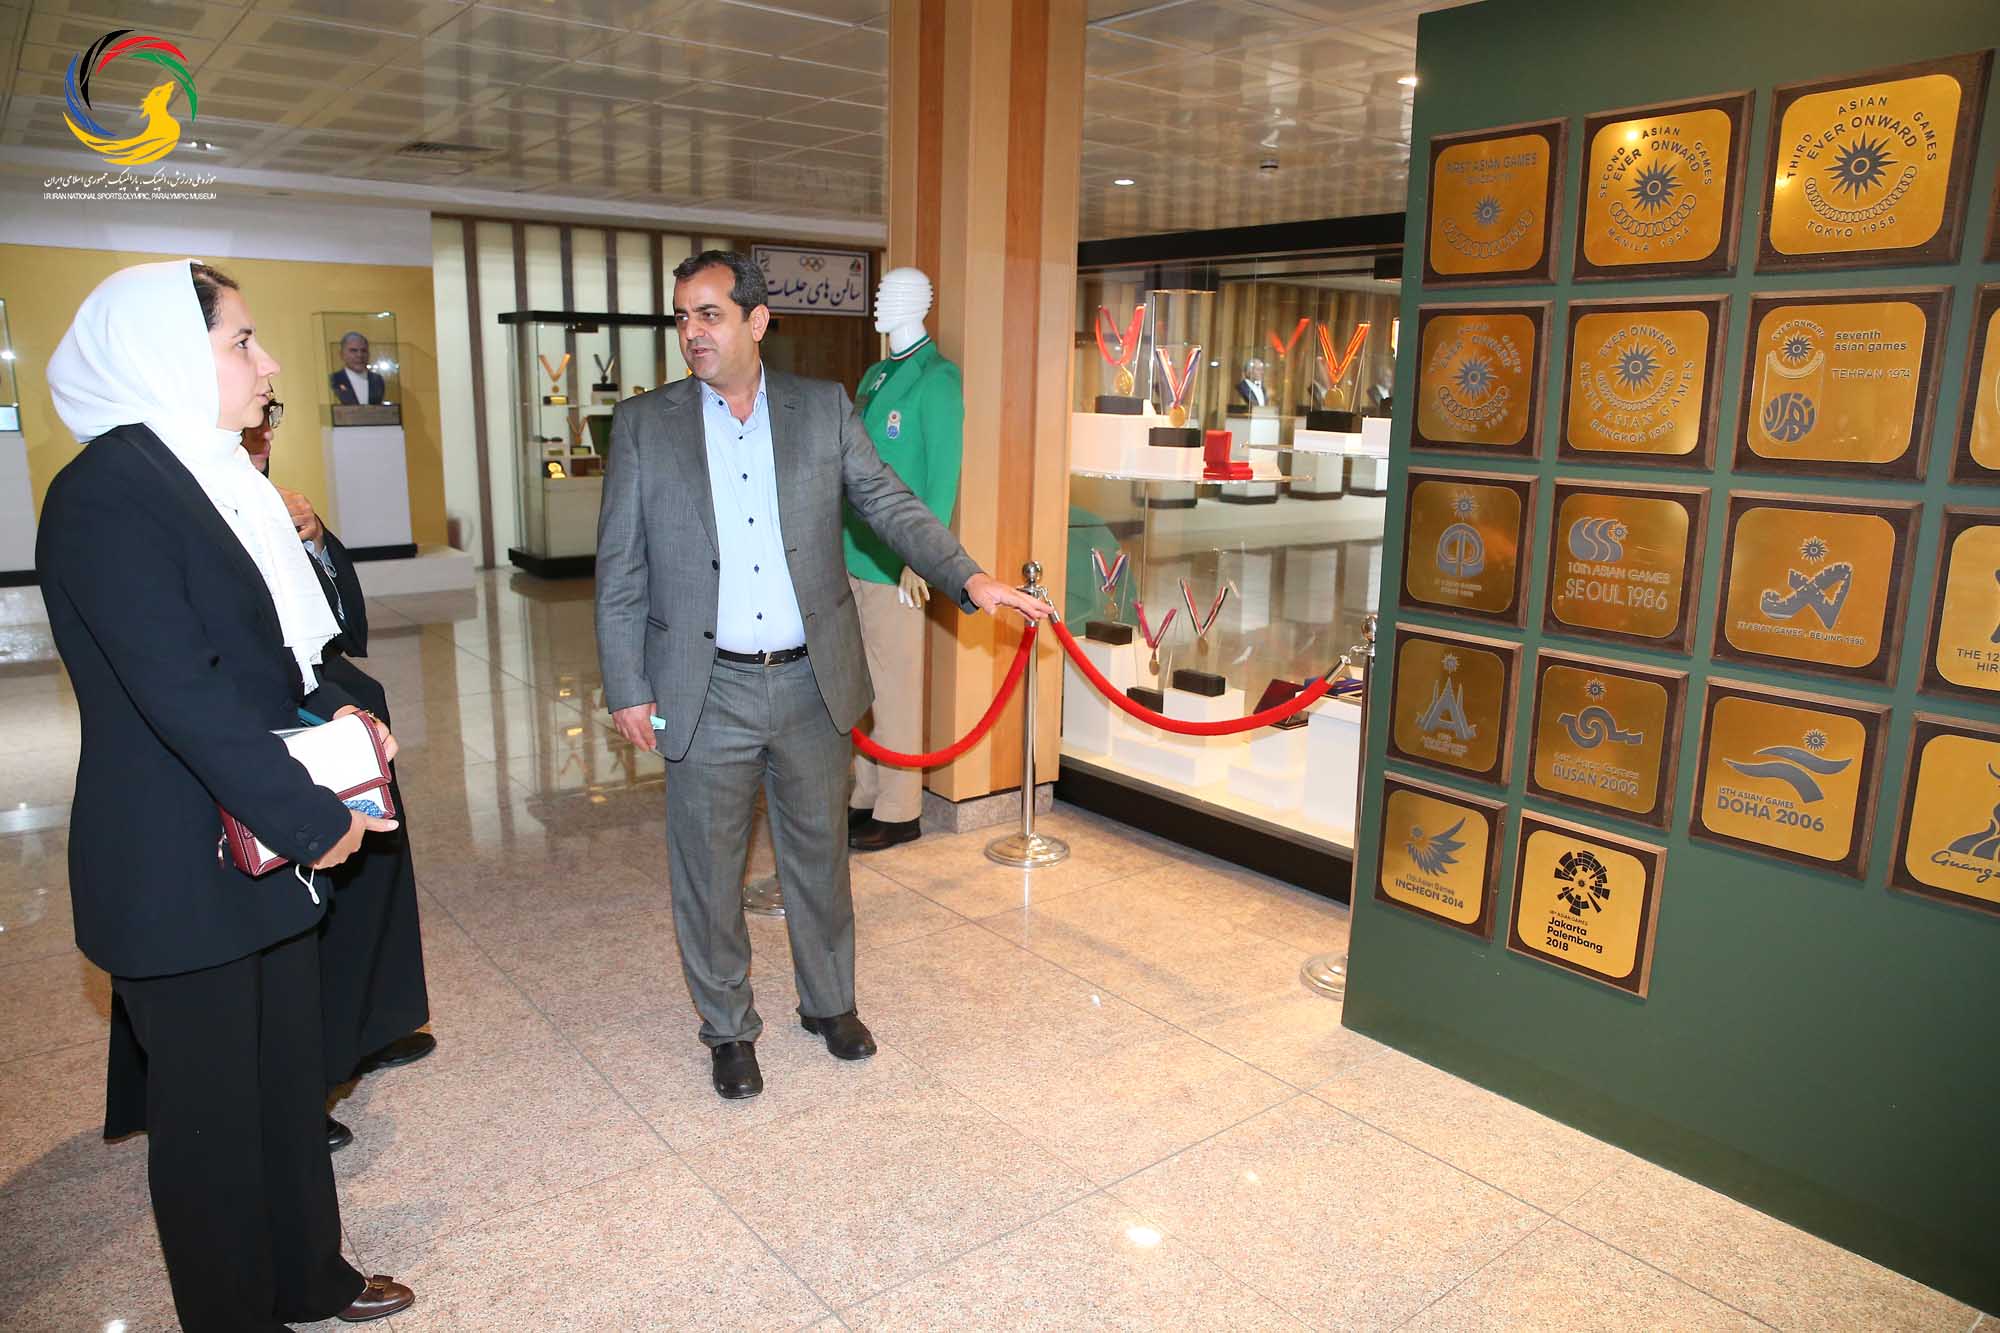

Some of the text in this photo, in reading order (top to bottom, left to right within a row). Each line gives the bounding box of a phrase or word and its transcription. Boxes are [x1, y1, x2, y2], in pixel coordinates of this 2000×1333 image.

[1787, 96, 1937, 179] THIRD ASIAN GAMES
[1807, 114, 1918, 160] EVER ONWARD
[1600, 126, 1712, 198] SECOND ASIAN GAMES
[1613, 140, 1700, 181] EVER ONWARD
[1807, 215, 1896, 238] TOKYO 1958
[768, 276, 861, 306] سالن های جلسات
[1600, 326, 1677, 357] EVER ONWARD
[1834, 342, 1907, 353] asian games
[1835, 330, 1881, 340] seventh
[1832, 368, 1884, 379] TEHRAN
[1591, 419, 1646, 442] BANGKOK
[1592, 565, 1627, 579] ASIAN
[1628, 569, 1671, 584] GAMES
[1565, 578, 1668, 611] SEOUL 1986
[1956, 648, 1982, 660] THE
[1552, 763, 1639, 796] BUSAN 2002
[1717, 794, 1825, 832] DOHA 2006
[1737, 791, 1763, 802] ASIAN
[1765, 796, 1794, 808] GAMES
[1395, 878, 1464, 909] INCHEON 2014
[1547, 926, 1603, 954] Palembang
[1548, 916, 1587, 936] Jakarta
[1546, 937, 1569, 952] 2018
